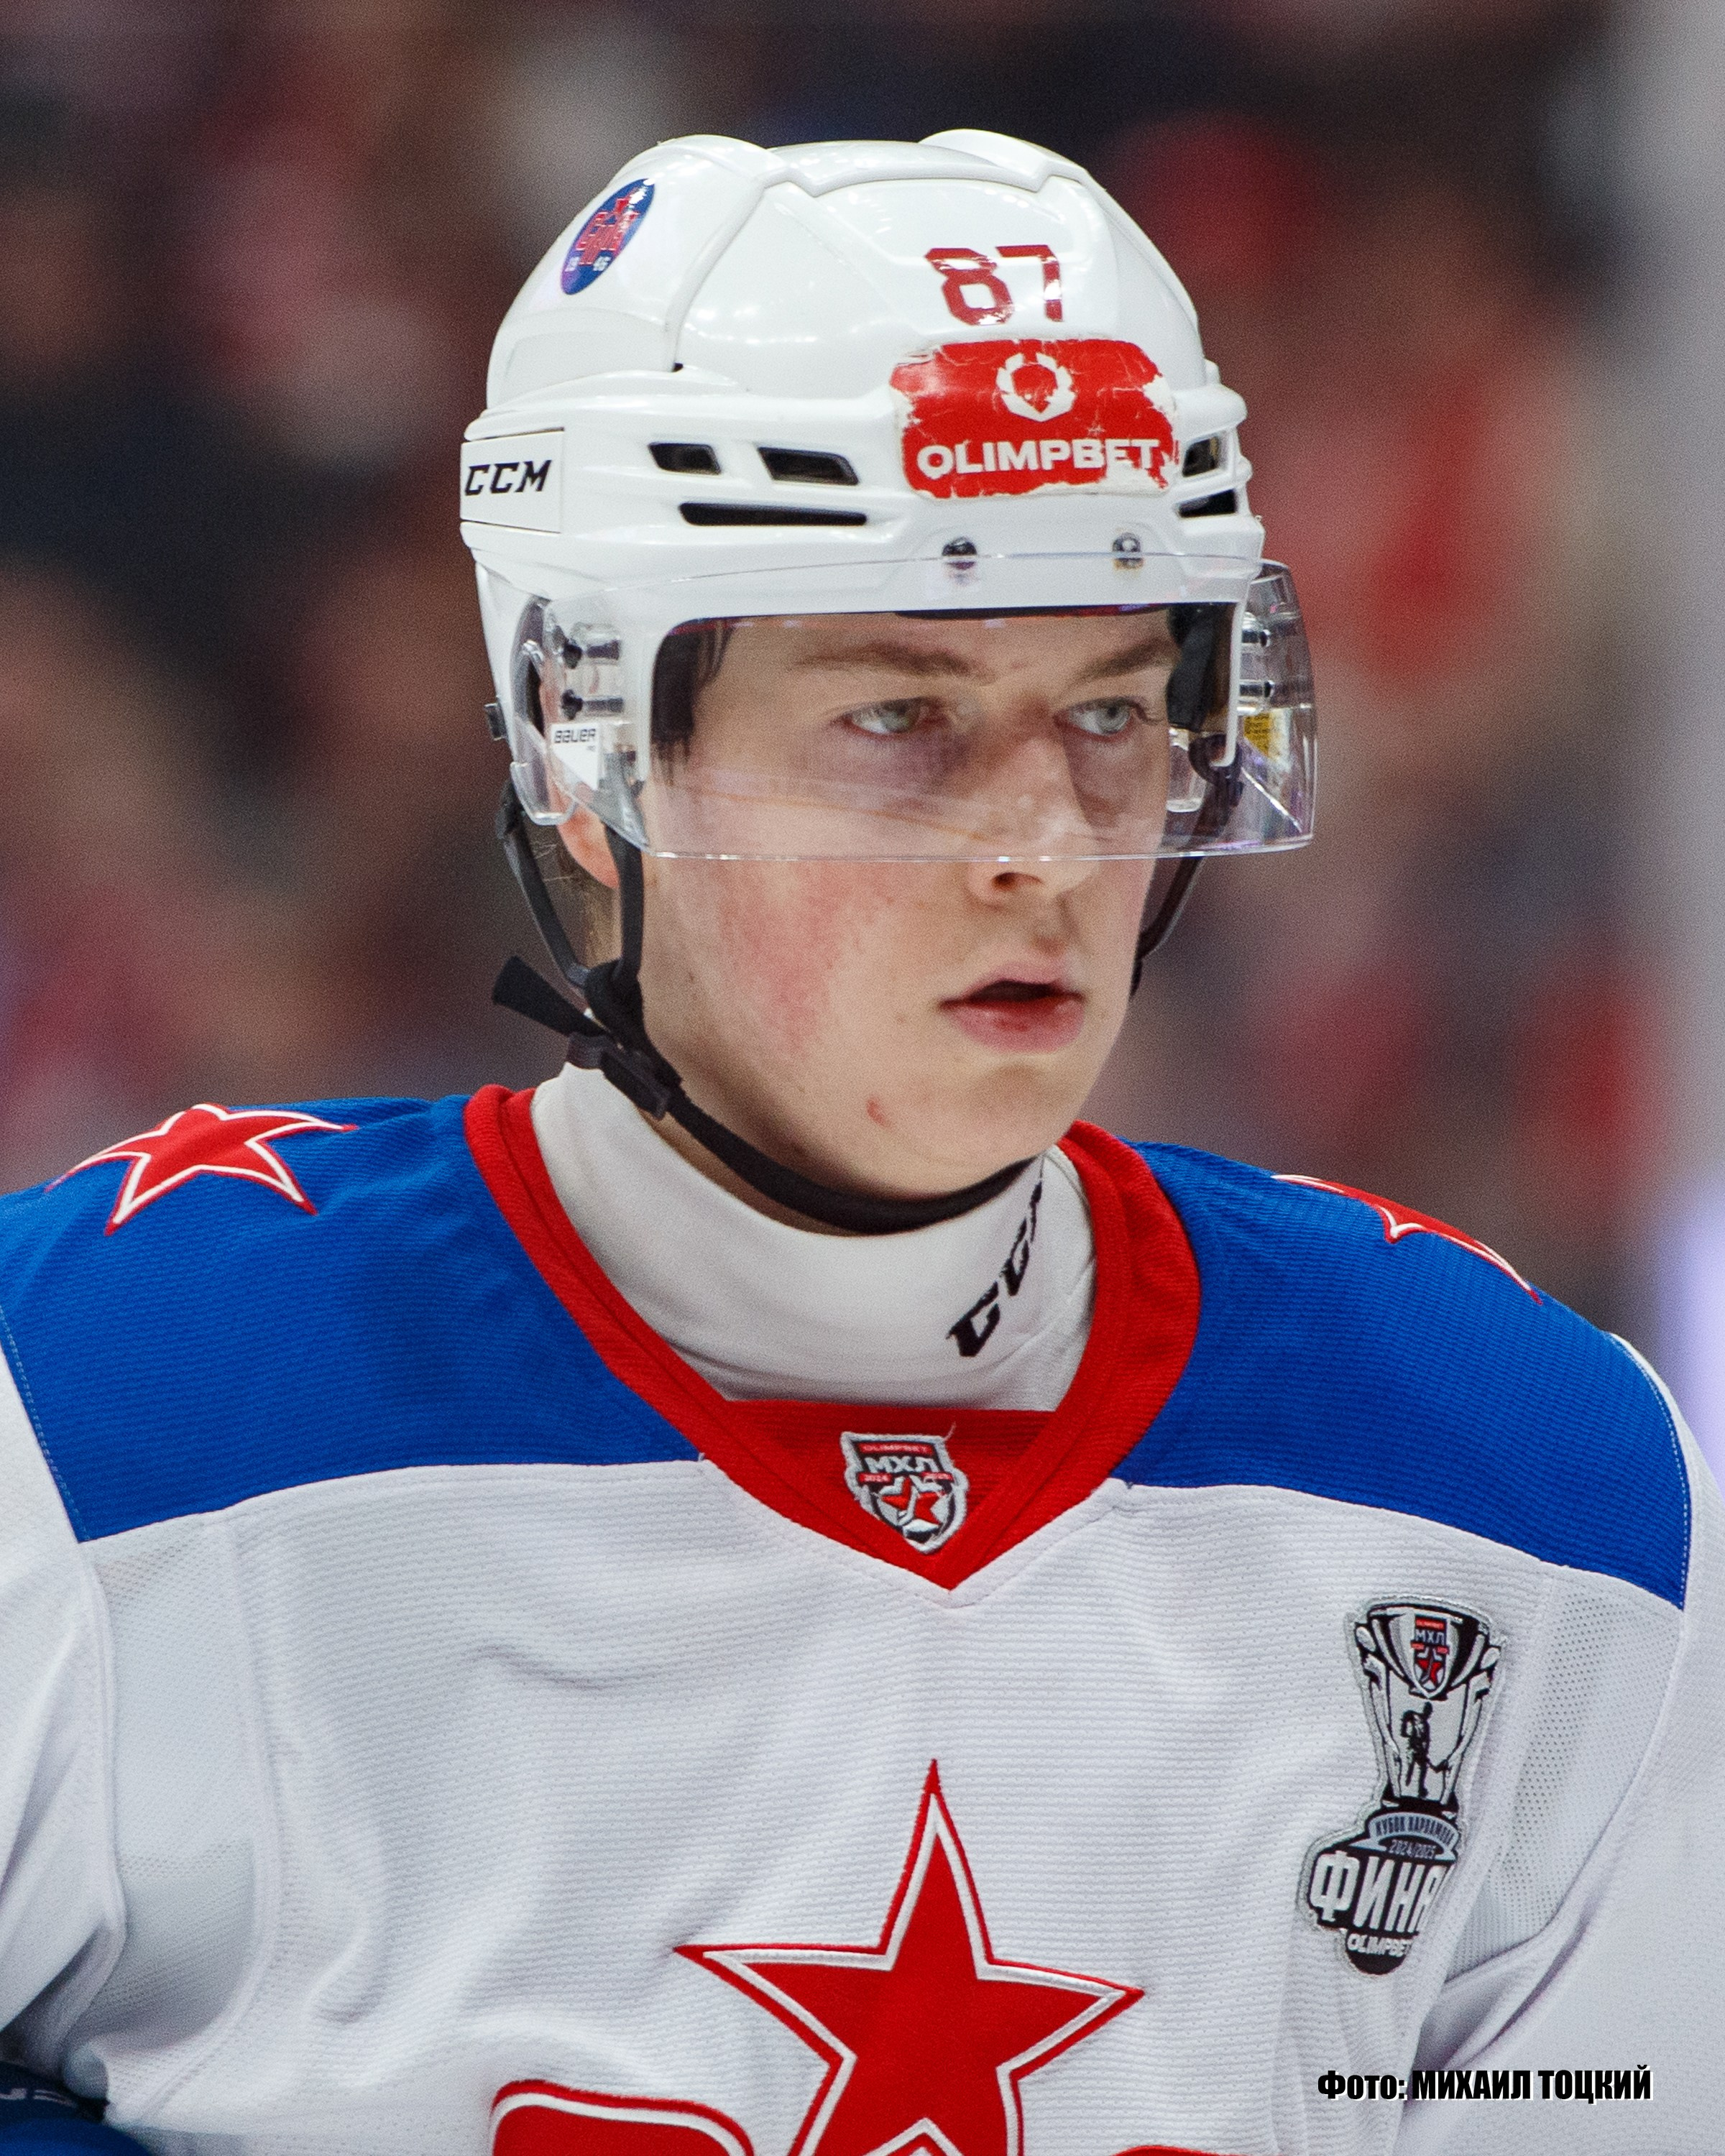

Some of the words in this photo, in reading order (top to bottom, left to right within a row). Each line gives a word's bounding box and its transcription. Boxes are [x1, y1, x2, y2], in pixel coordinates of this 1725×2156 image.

[924, 244, 1064, 326] 87
[464, 459, 553, 497] CCM
[916, 438, 1162, 479] OLIMPBET
[864, 1455, 939, 1474] МХЛ
[1414, 1628, 1445, 1645] МХЛ
[1310, 1850, 1450, 1934] ФИНА
